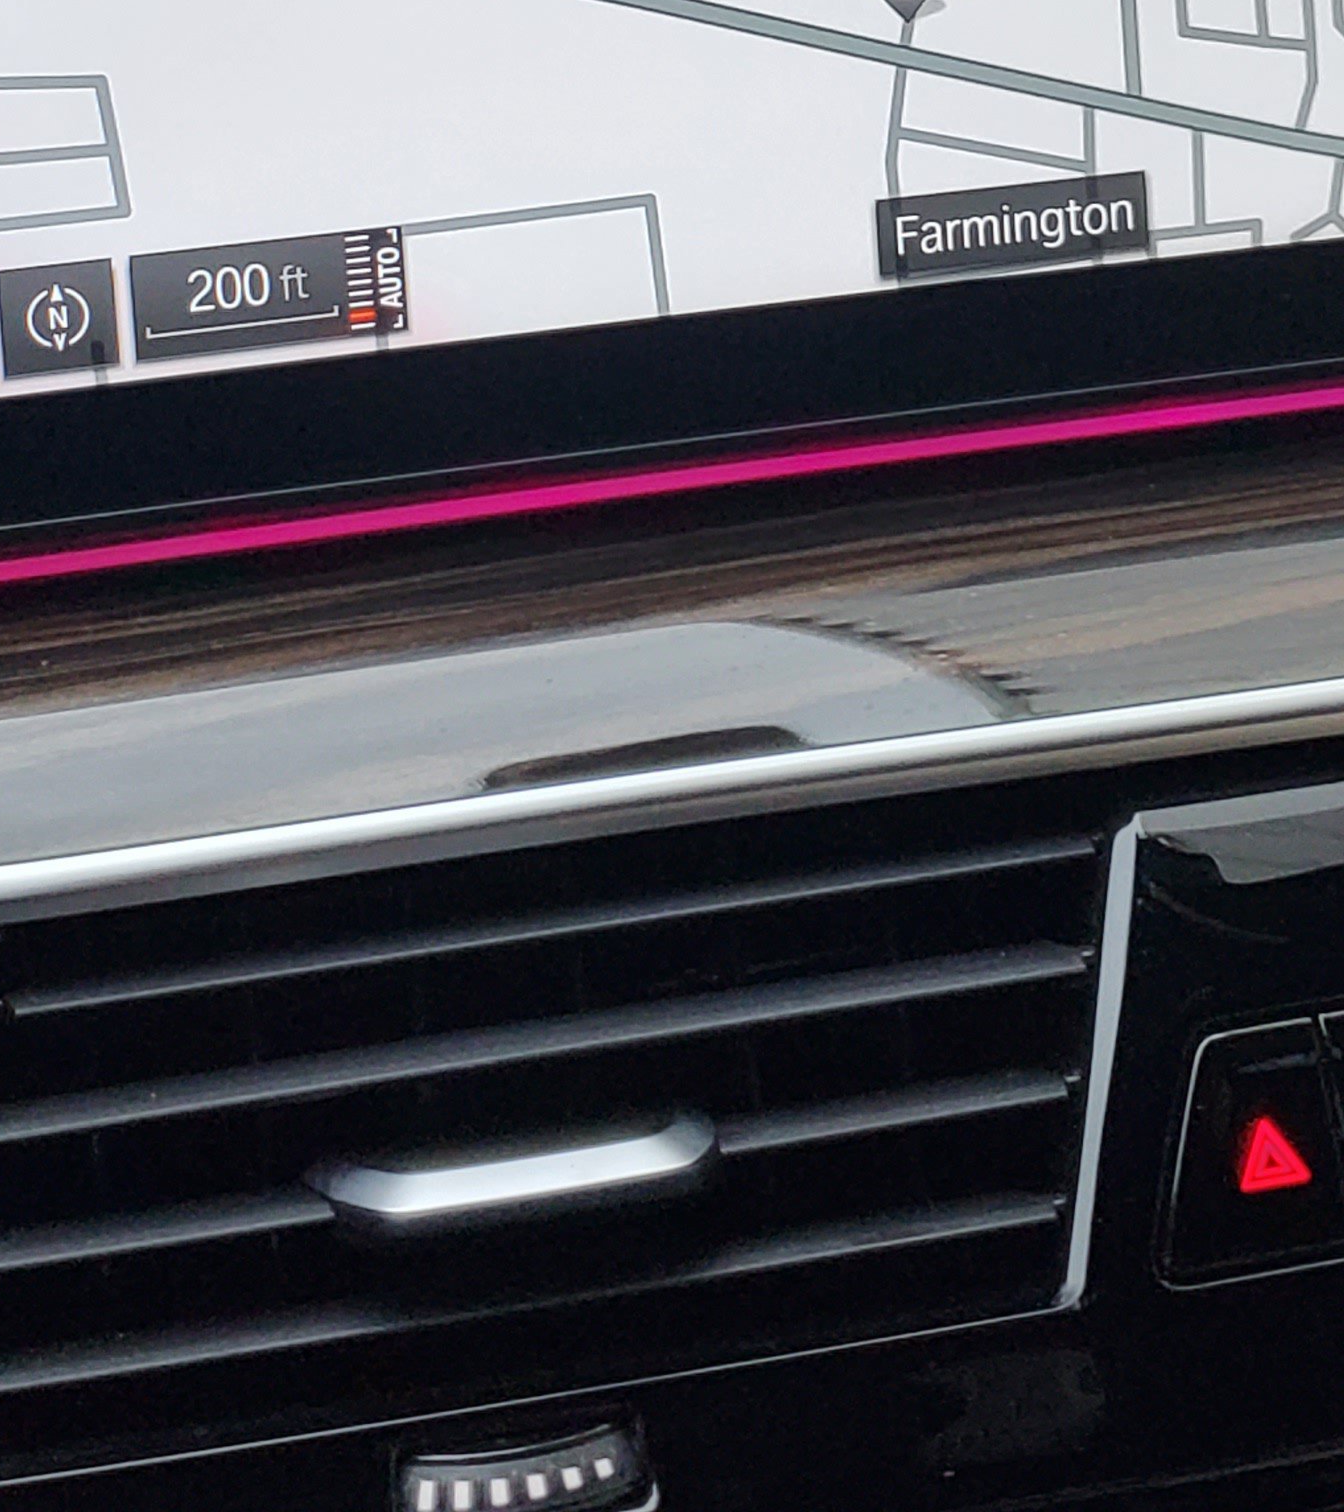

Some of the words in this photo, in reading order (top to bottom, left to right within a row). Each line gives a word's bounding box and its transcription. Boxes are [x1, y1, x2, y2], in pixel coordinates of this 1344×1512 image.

[895, 198, 1134, 256] Farmington
[186, 263, 271, 314] 200
[278, 264, 310, 302] ft
[377, 246, 404, 309] AUTO
[49, 306, 69, 329] N
